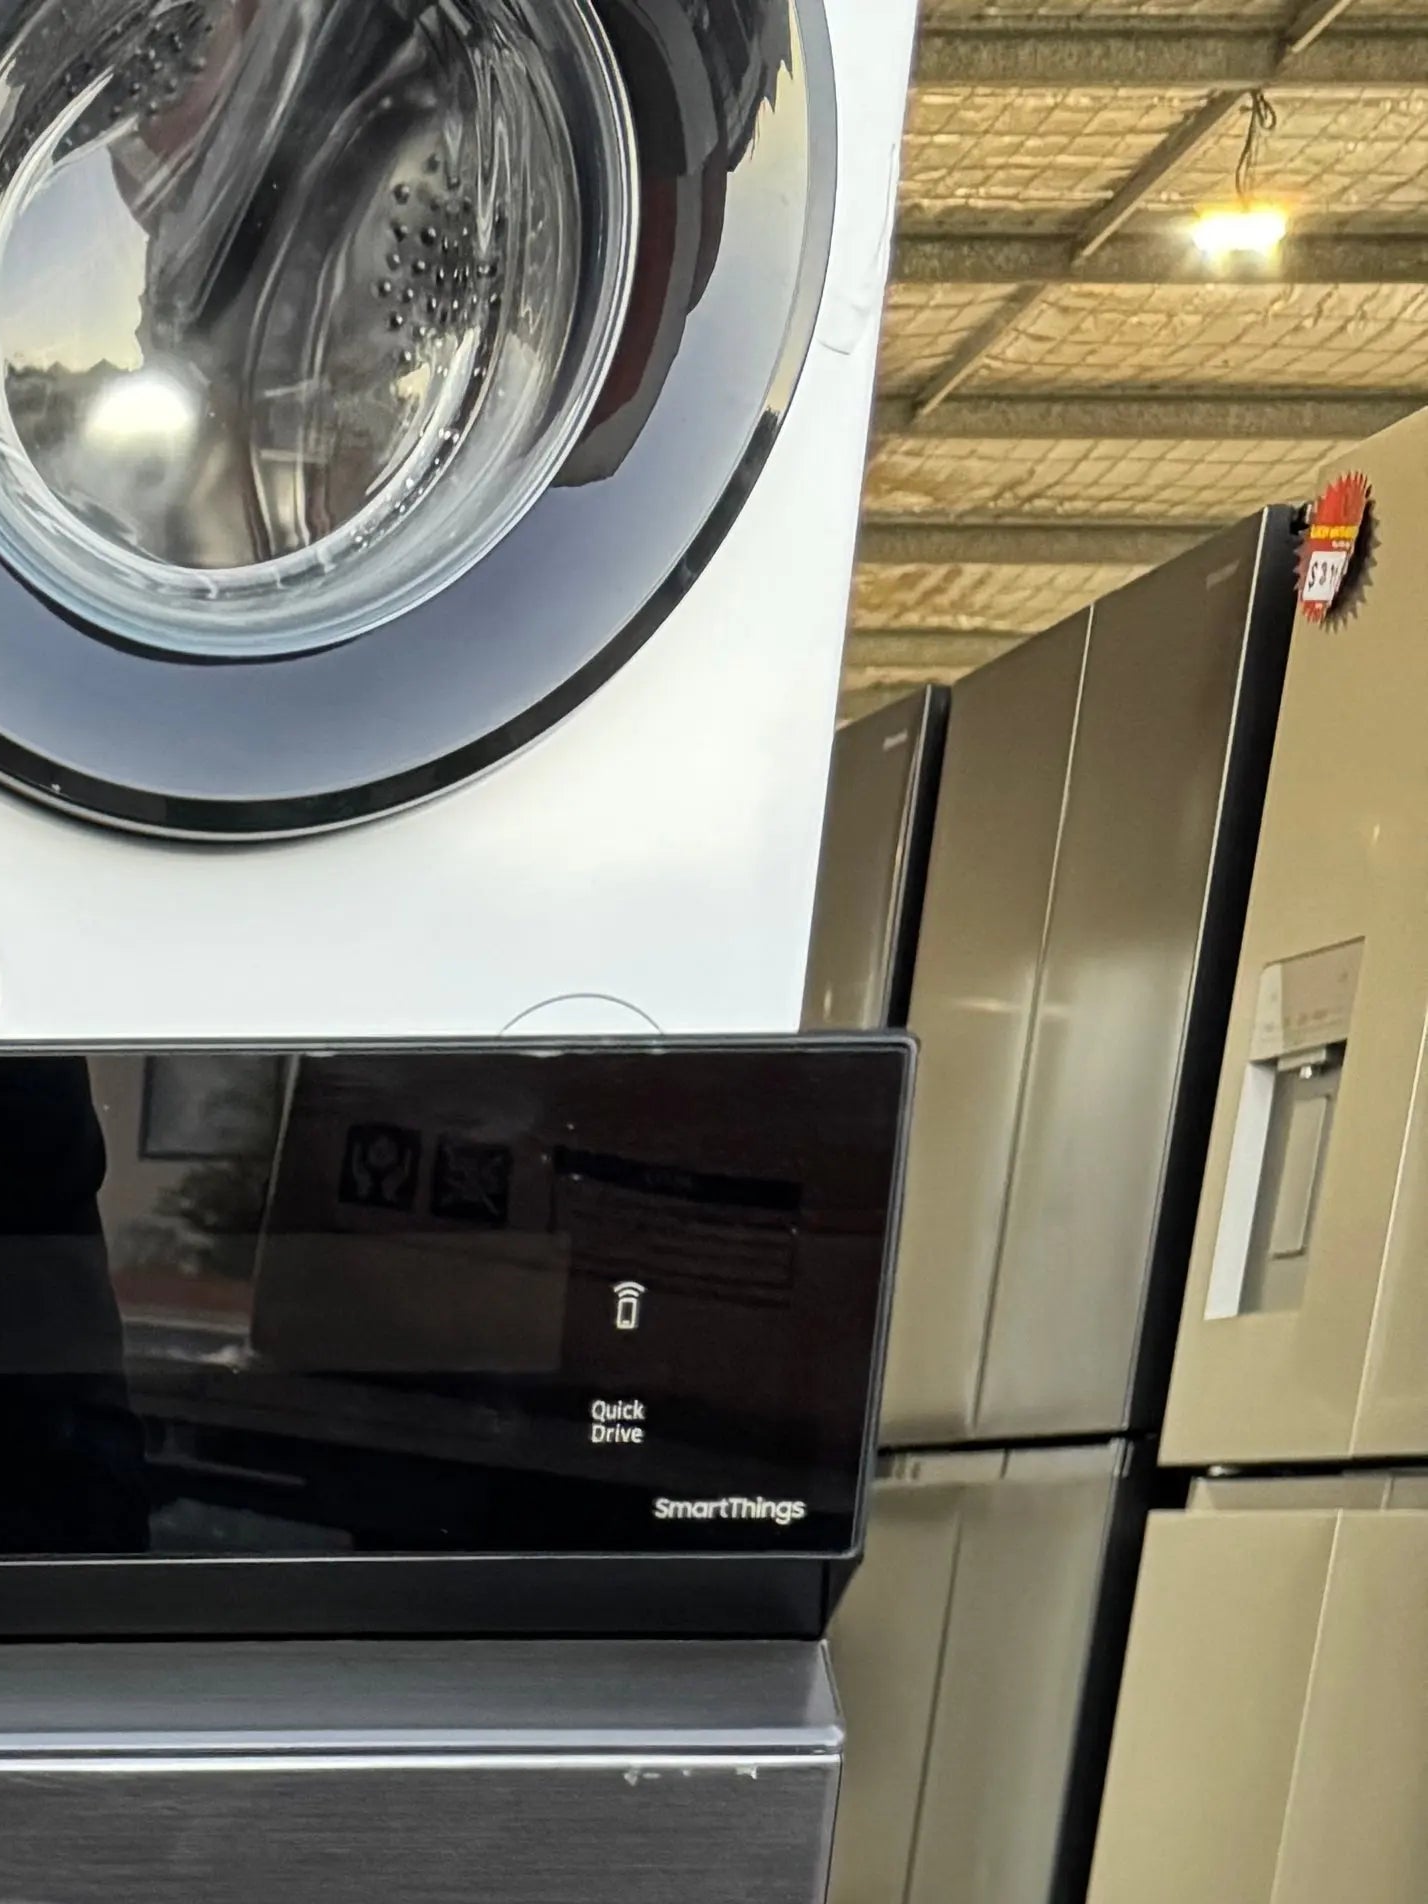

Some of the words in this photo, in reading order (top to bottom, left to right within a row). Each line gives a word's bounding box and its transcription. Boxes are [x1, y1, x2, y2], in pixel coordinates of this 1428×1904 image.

[591, 1400, 645, 1421] Quick
[591, 1424, 643, 1443] Drive
[654, 1497, 806, 1525] SmartThings
